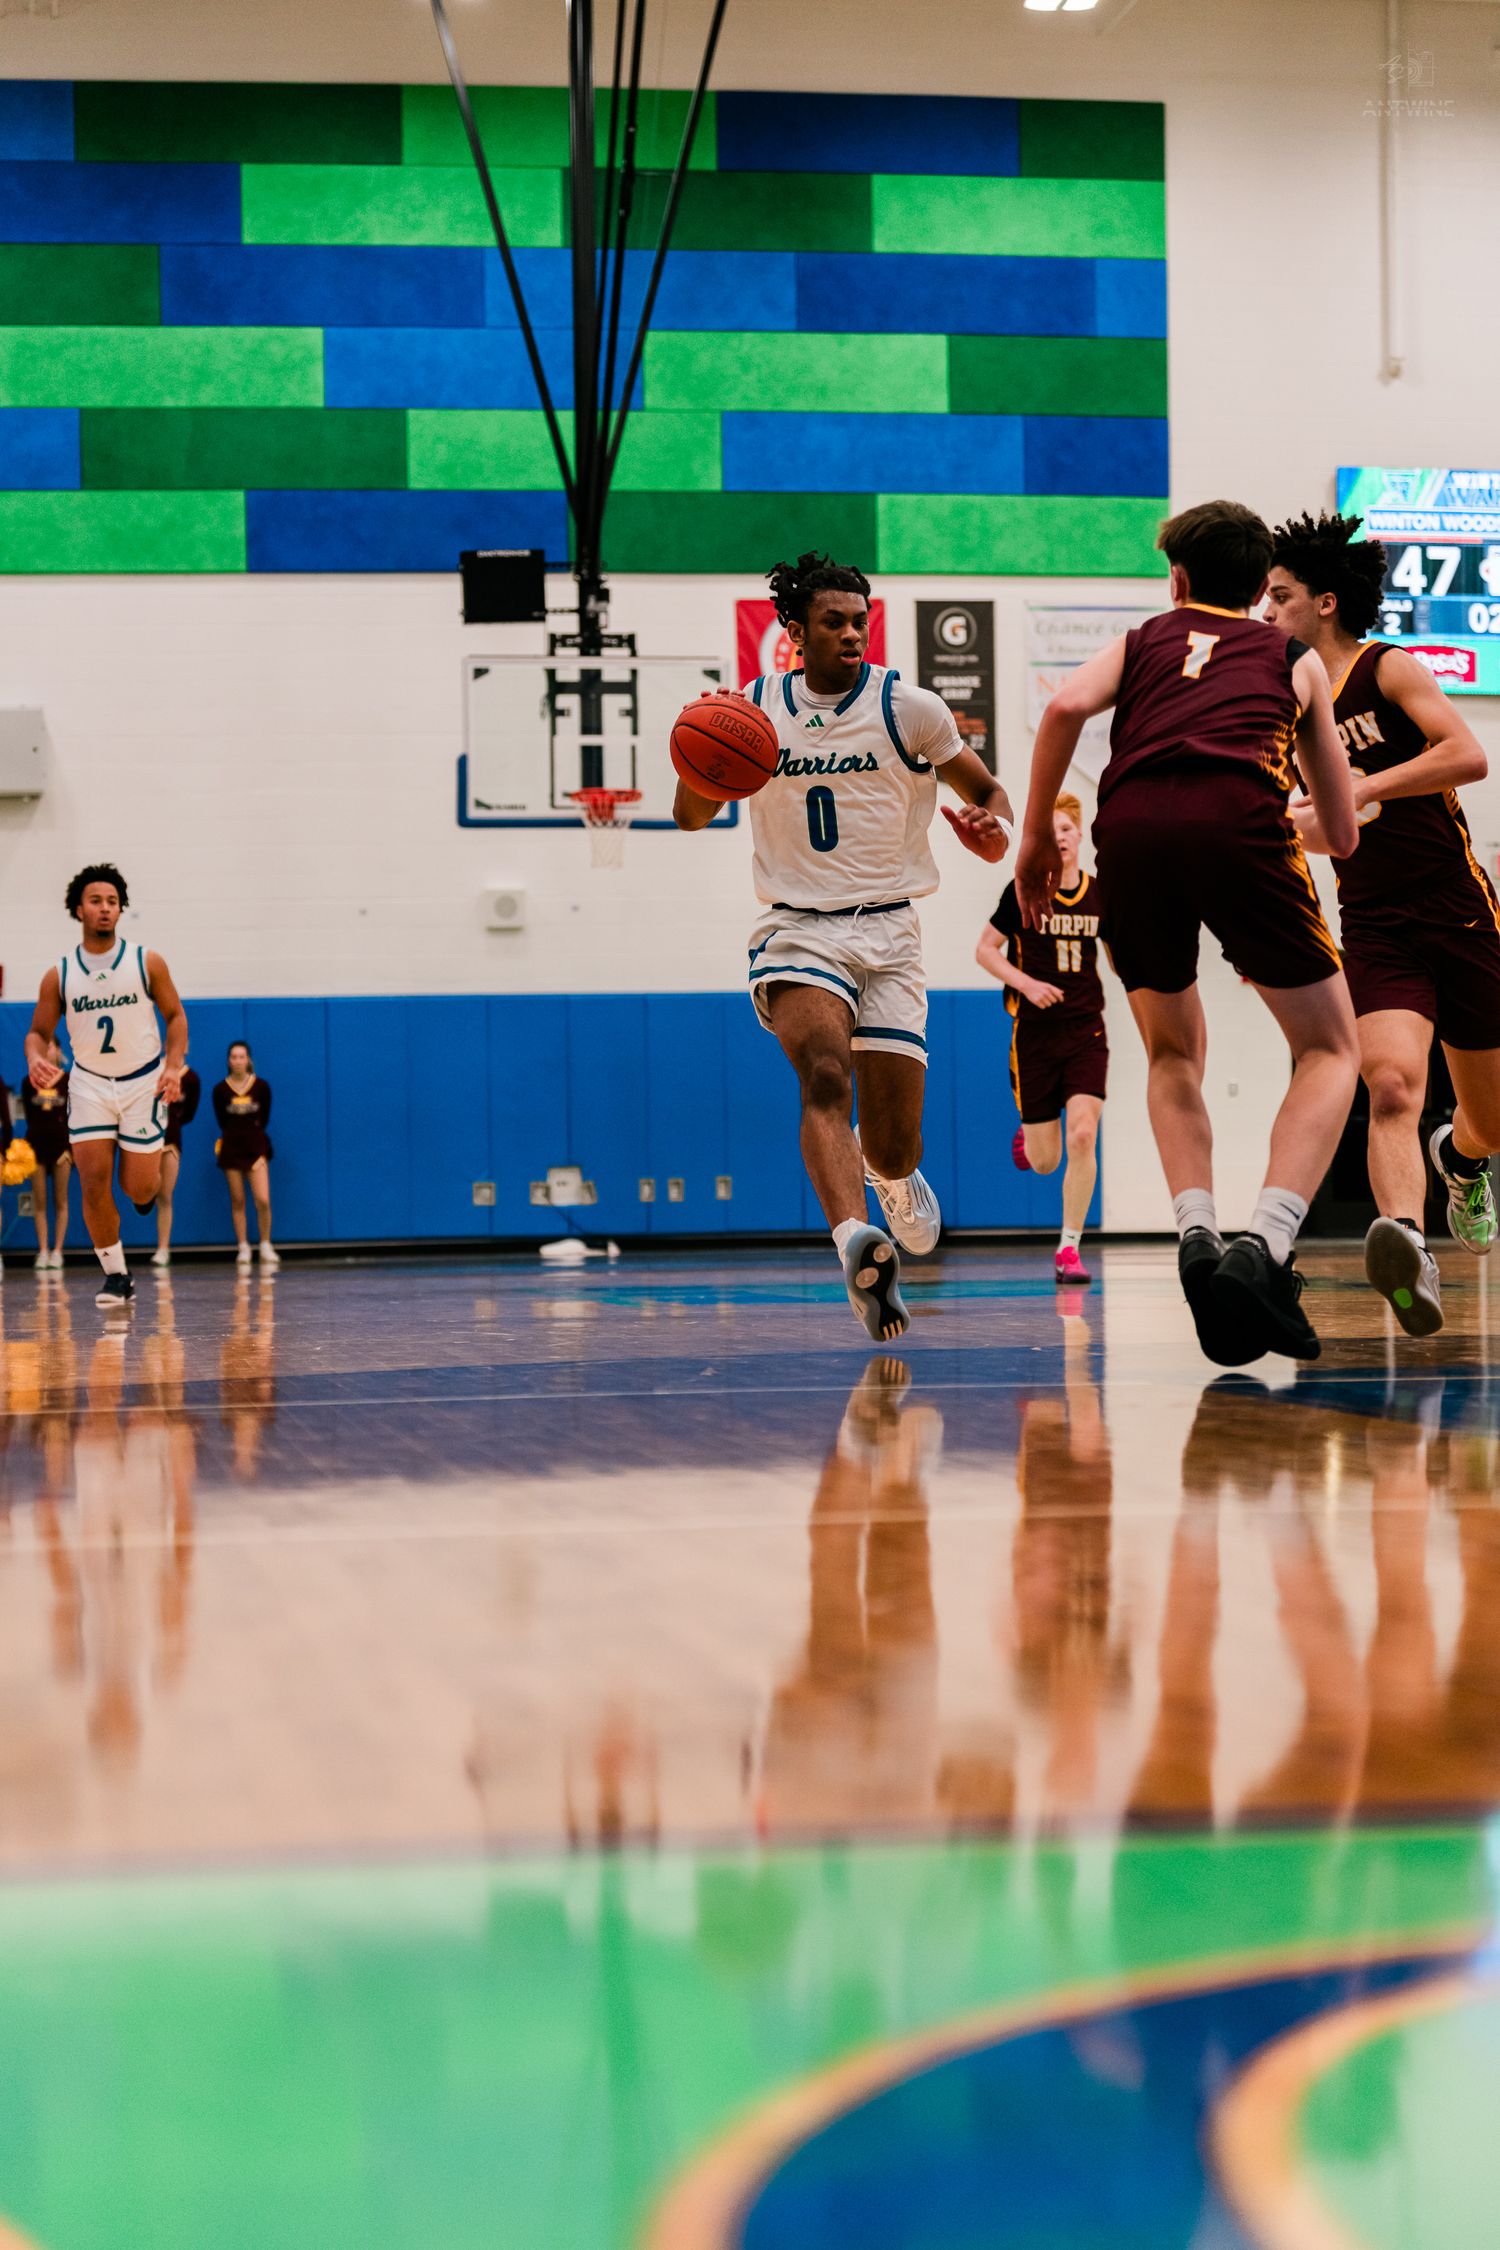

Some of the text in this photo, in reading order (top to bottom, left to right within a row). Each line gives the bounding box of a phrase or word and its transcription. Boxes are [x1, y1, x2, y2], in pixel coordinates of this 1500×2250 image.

[1369, 512, 1500, 533] WINTON WOOD
[1392, 545, 1462, 597] 47
[941, 615, 968, 647] G
[1383, 613, 1402, 636] 2
[1468, 603, 1500, 634] 02
[806, 785, 839, 852] 0
[1056, 939, 1082, 972] 11
[72, 993, 138, 1013] Warriors
[97, 1015, 117, 1054] 2
